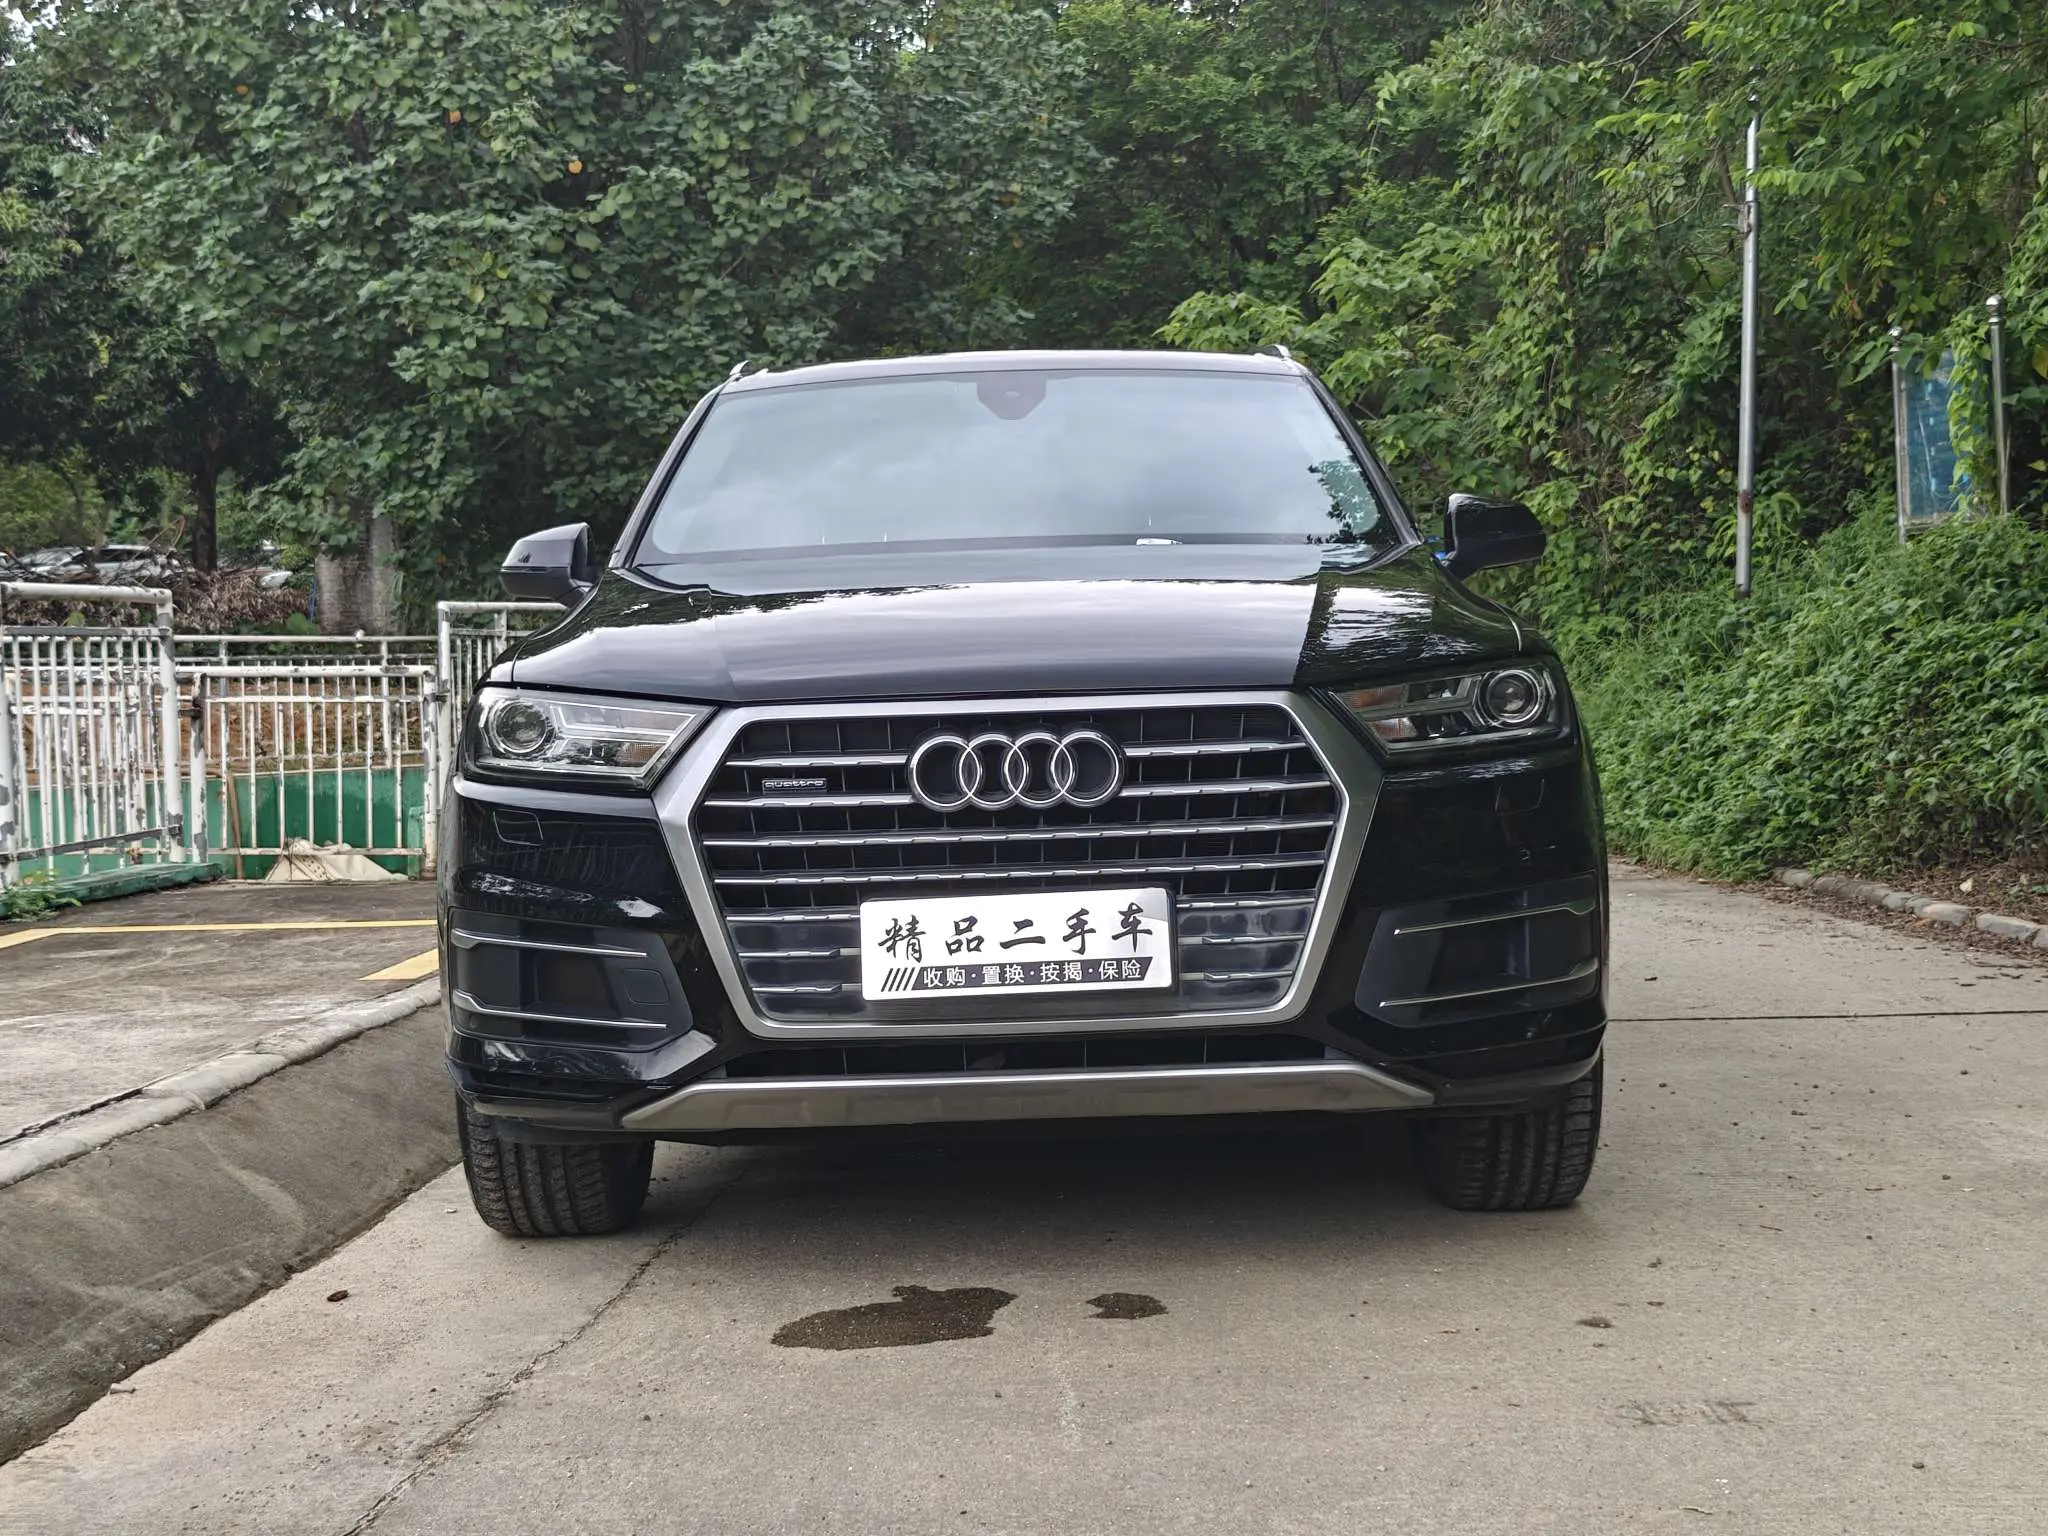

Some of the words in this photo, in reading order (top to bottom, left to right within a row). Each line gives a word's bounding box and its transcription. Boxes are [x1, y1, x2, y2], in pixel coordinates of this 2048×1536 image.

[764, 780, 824, 789] quattro
[878, 902, 1153, 963] 精品二手车
